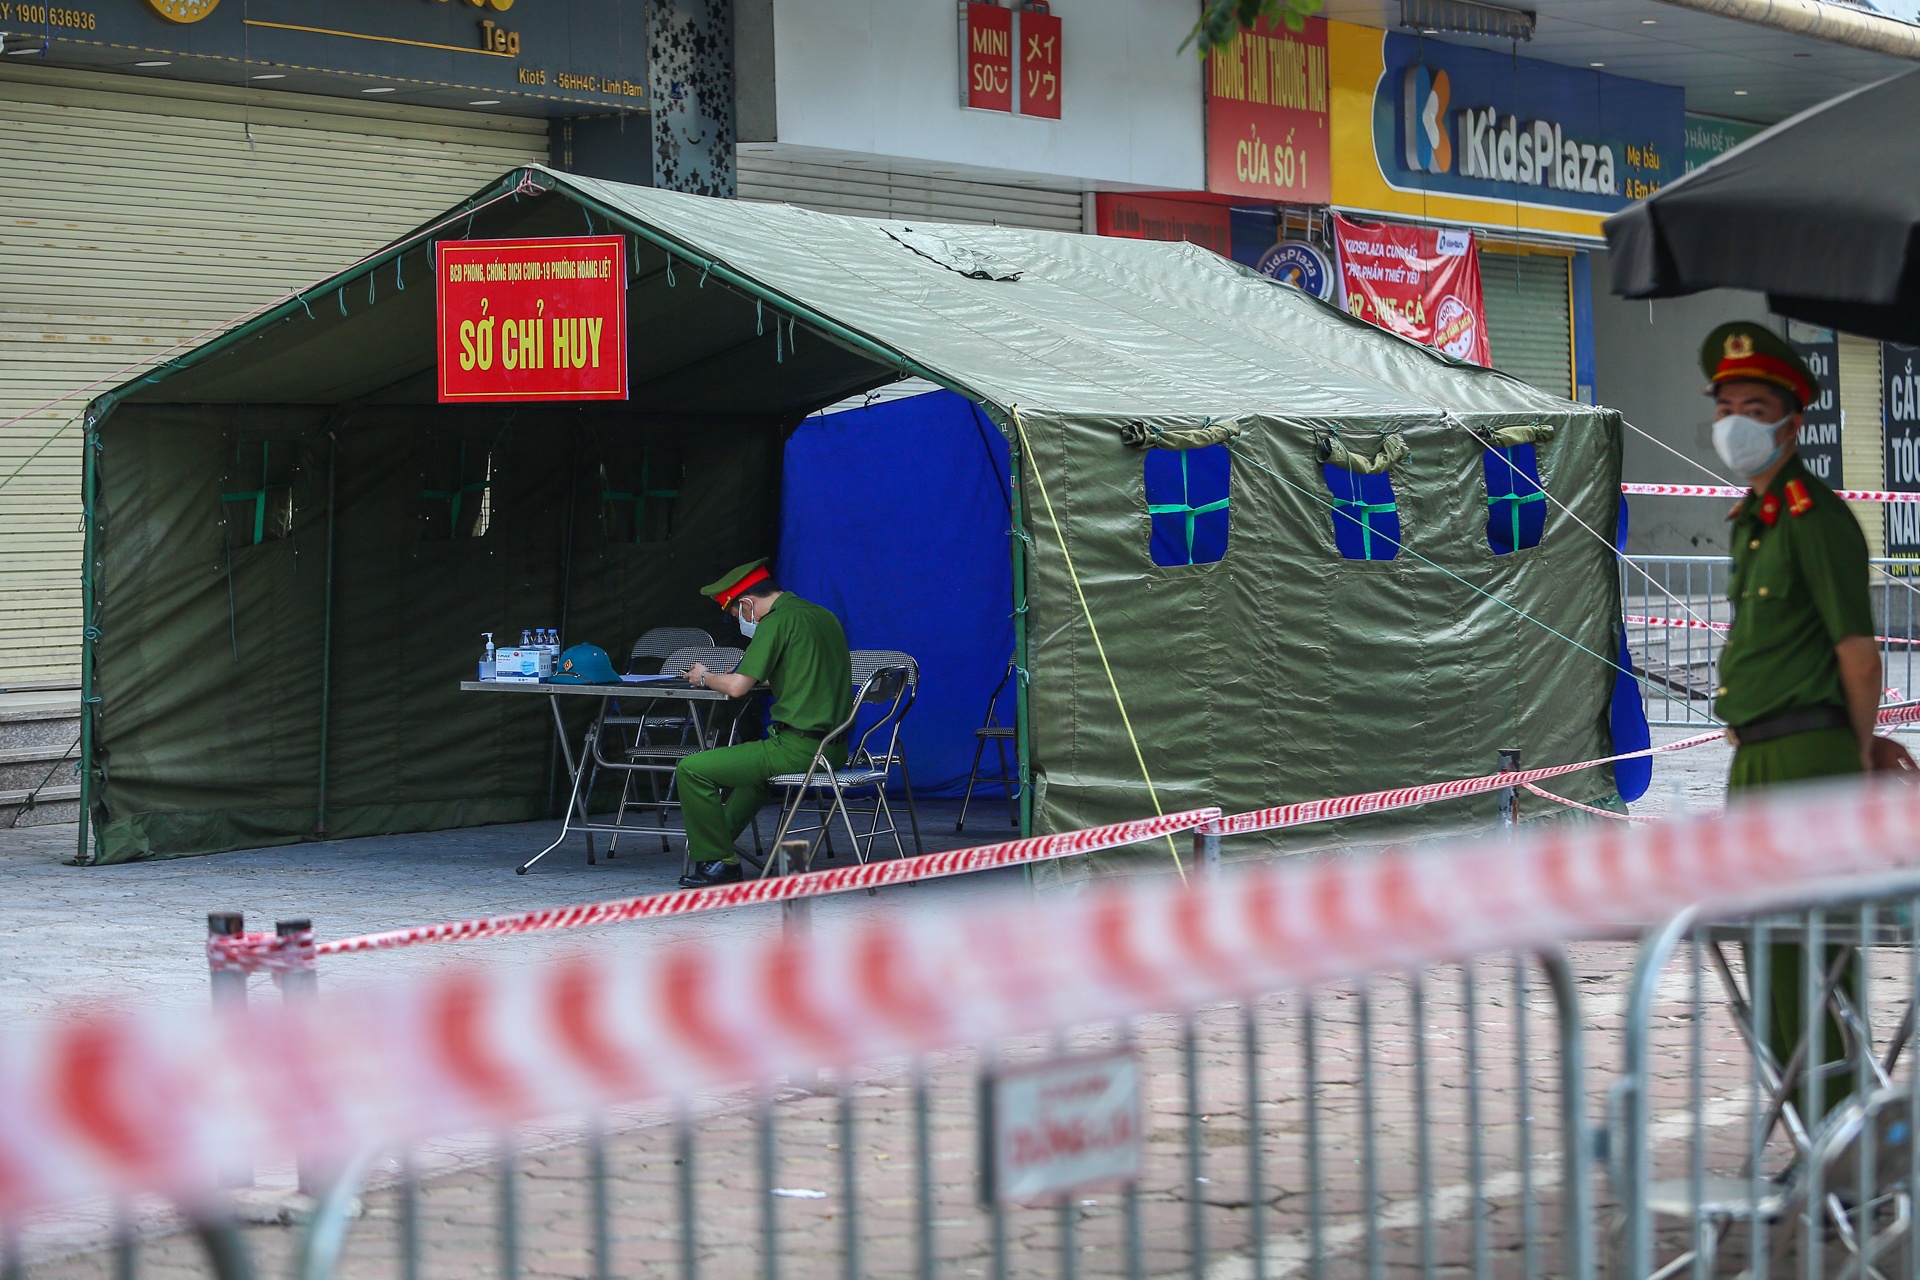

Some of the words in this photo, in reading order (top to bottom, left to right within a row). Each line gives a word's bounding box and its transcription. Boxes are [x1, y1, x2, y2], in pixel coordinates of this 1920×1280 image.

[16, 4, 46, 24] 1900
[49, 8, 96, 31] 636936
[481, 20, 520, 54] Tea
[973, 26, 1008, 58] MINI
[519, 68, 546, 86] Kiot5
[602, 78, 621, 95] Linh
[1237, 123, 1271, 185] CỬA
[1274, 127, 1296, 189] SỐ
[1300, 150, 1306, 189] 1
[1459, 105, 1616, 196] KidsPlaza
[1627, 145, 1641, 173] Mẹ
[1643, 141, 1660, 171] bầu
[1634, 179, 1648, 200] Em
[1262, 249, 1317, 277] KidsPlaza
[1345, 239, 1385, 257] KIDSPLAZA
[486, 256, 507, 282] CHỐNG
[508, 262, 522, 285] DỊCH
[523, 261, 550, 281] COVID-19
[551, 256, 576, 279] PHƯỜNG
[577, 256, 598, 279] HOÀNG
[598, 255, 612, 282] LIỆT
[1405, 294, 1426, 325] CÁ
[459, 297, 495, 371] SỞ
[502, 298, 544, 370] CHỈ
[552, 317, 603, 369] HUY
[1795, 423, 1837, 446] NAM
